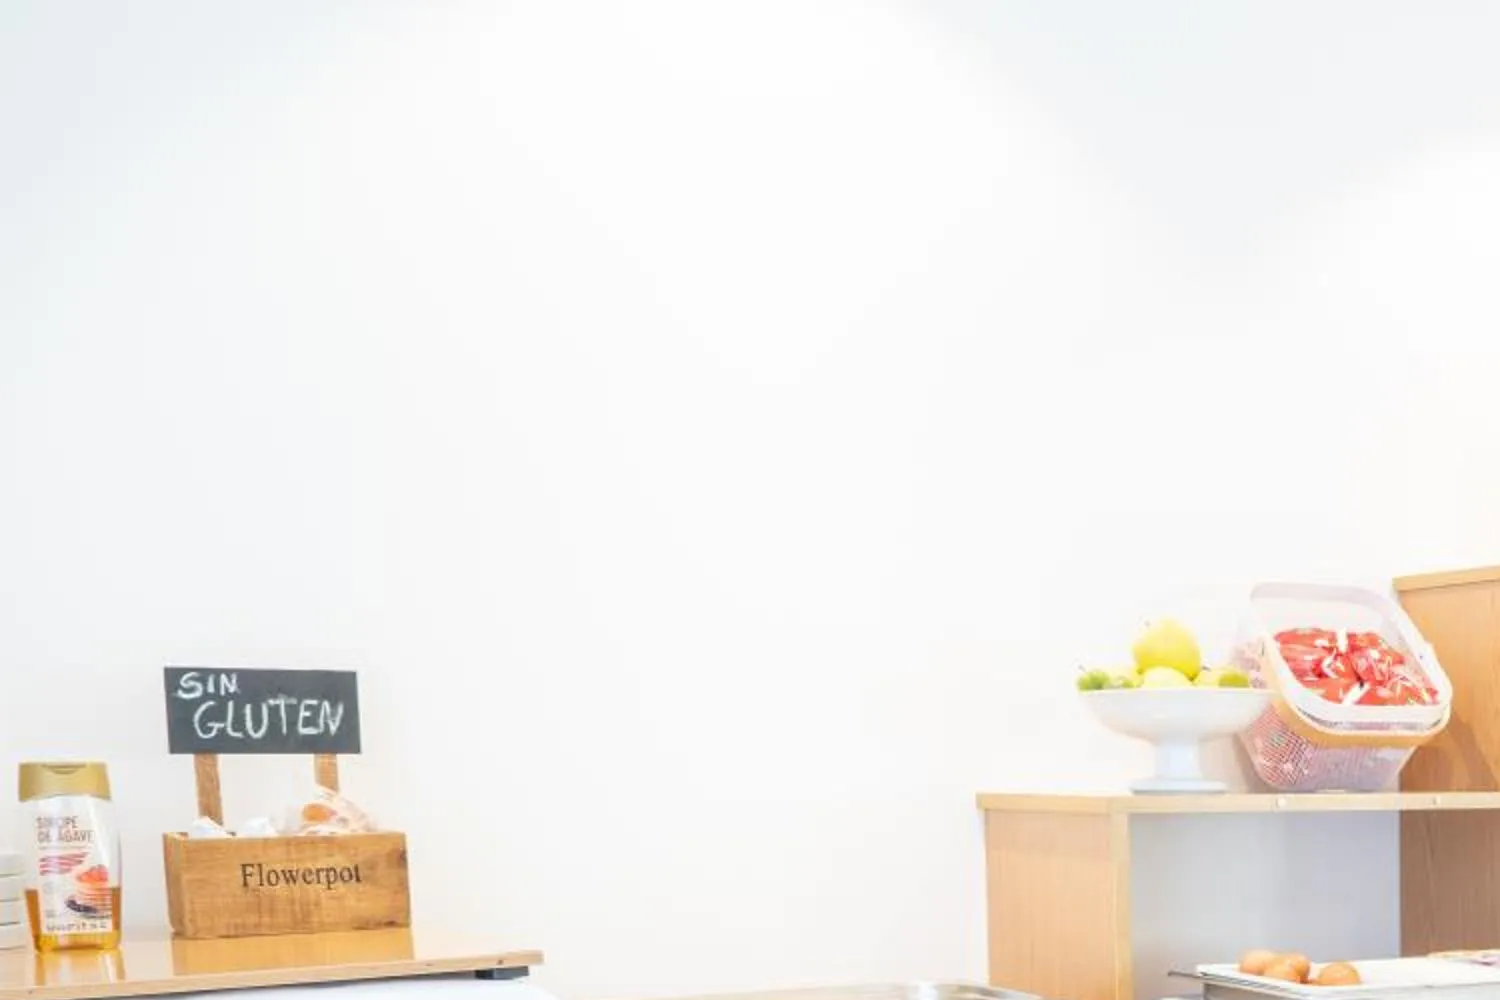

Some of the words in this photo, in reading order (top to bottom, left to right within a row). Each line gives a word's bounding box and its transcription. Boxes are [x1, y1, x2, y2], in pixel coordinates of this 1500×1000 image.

[177, 671, 240, 699] SIN
[193, 693, 344, 738] GLUTEN
[240, 863, 362, 890] Flowerpot
